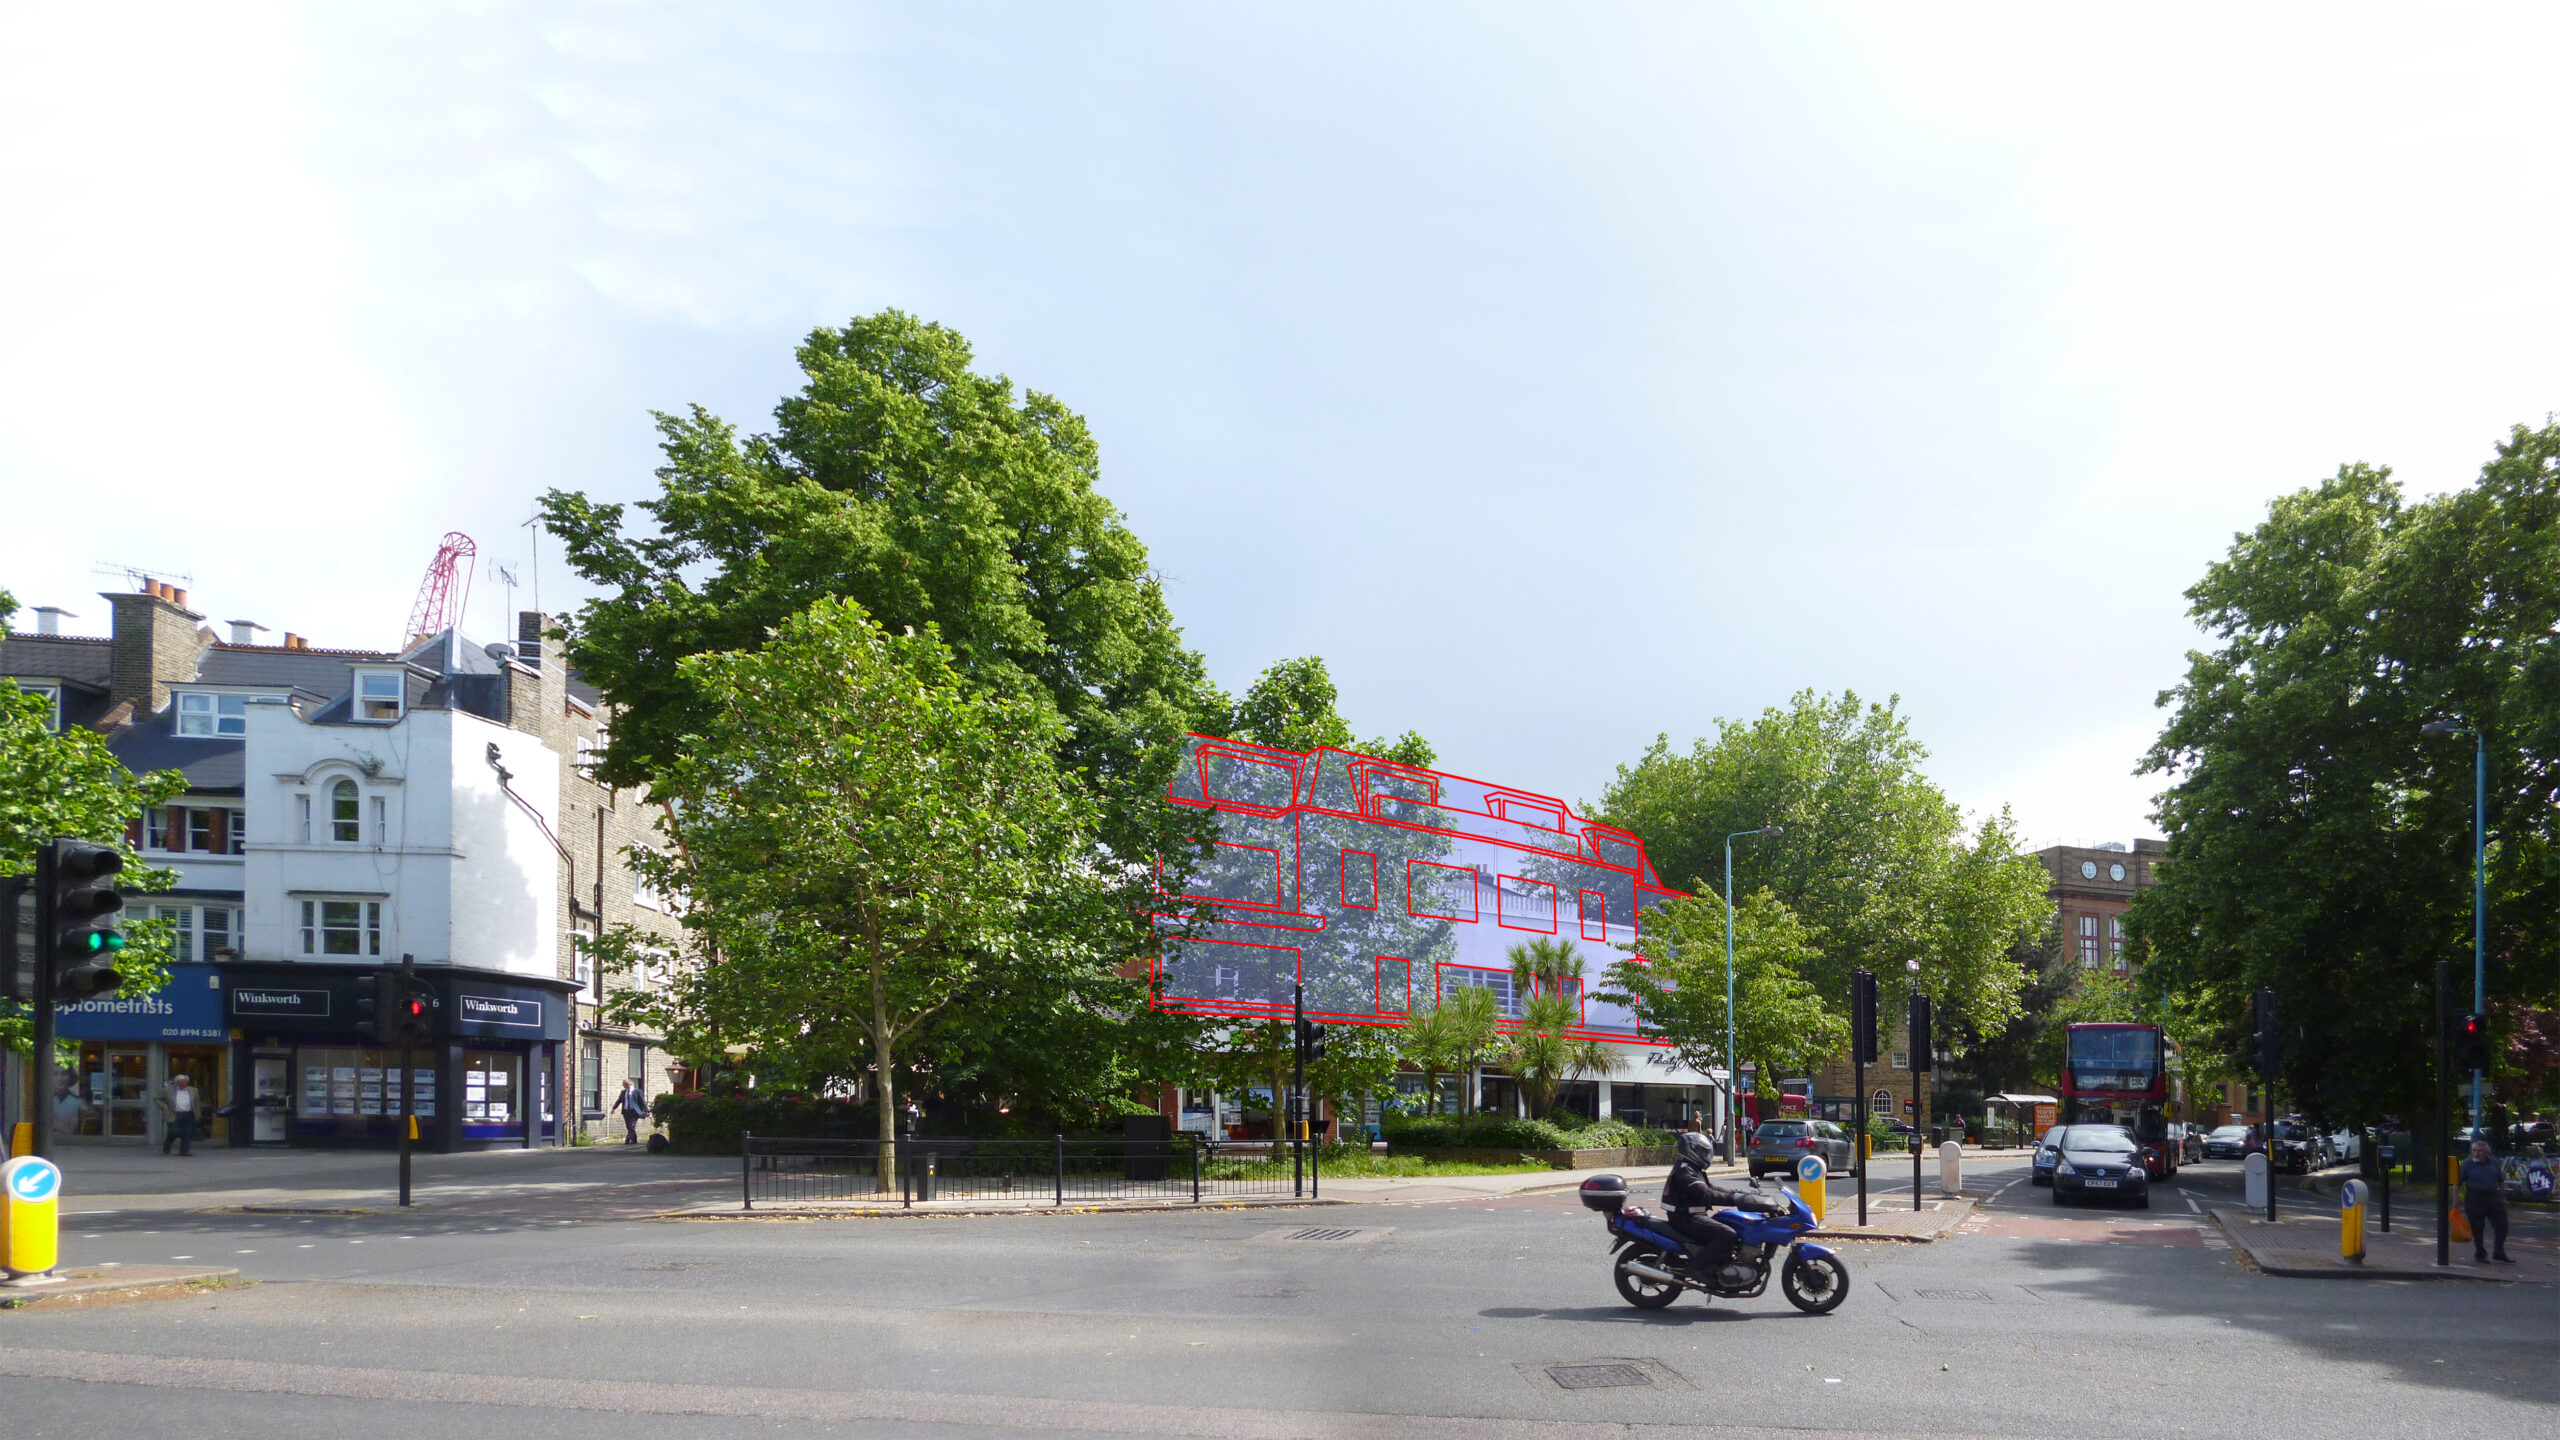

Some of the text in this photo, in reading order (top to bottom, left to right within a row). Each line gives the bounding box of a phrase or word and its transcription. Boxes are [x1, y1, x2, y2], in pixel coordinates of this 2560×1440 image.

[238, 992, 301, 1004] Winkworth
[464, 999, 519, 1014] Winkworth
[162, 1028, 222, 1037] 020 8994 5381
[1647, 1051, 1678, 1073] Felicity
